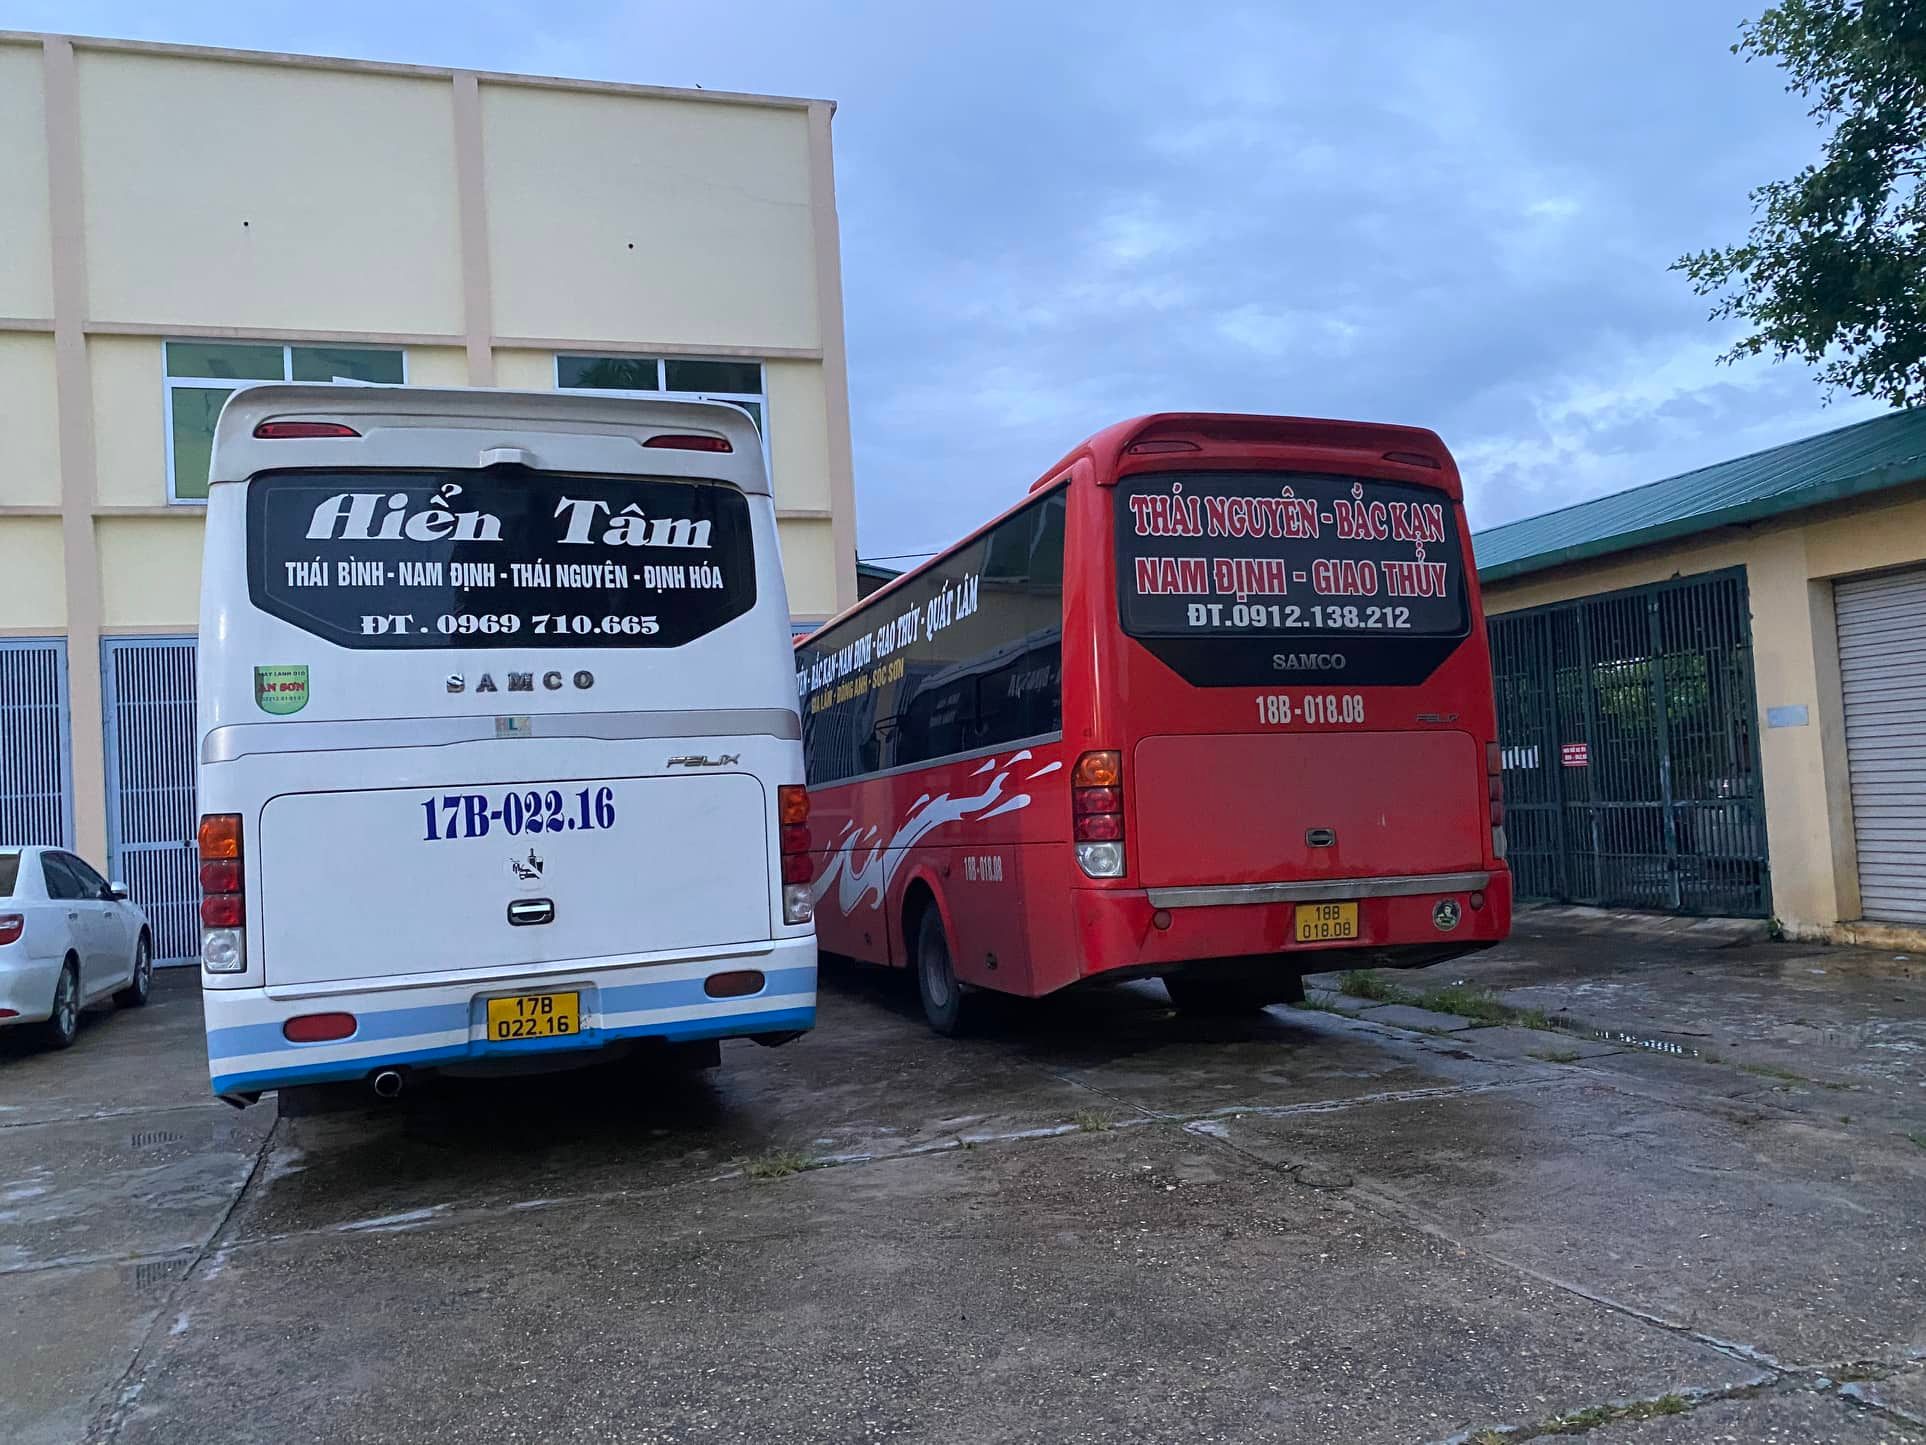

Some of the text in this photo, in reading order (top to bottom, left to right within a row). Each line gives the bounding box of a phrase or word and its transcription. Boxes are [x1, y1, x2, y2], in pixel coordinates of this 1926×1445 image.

[305, 483, 713, 549] Hiển Tâm
[1204, 485, 1319, 539] NGUYÊN
[1389, 501, 1445, 550] KẠN
[285, 555, 329, 588] THÁI
[337, 555, 384, 588] BÌNH
[398, 562, 443, 588] NAM
[449, 562, 496, 594] ĐỊNH
[510, 557, 551, 589] THÁI
[556, 559, 629, 590] NGUYÊN
[643, 564, 686, 595] ĐỊNH
[689, 559, 724, 590] HÓA
[1135, 557, 1210, 595] NAM
[1214, 558, 1287, 602] ĐỊNH
[1312, 559, 1378, 597] GIAO
[1382, 548, 1447, 598] THỦY
[436, 613, 521, 635] 0969
[531, 613, 661, 635] 710.665
[877, 620, 896, 659] GIAO
[926, 579, 954, 642] QUẤT
[955, 572, 979, 621] LÂM
[1272, 653, 1346, 670] SAMCO
[445, 670, 595, 694] SAMCO
[421, 785, 617, 841] 17B-022.16
[1315, 905, 1341, 922] 18B
[1302, 921, 1352, 939] 018.08
[515, 995, 554, 1017] 17B
[497, 1015, 570, 1039] 022.16
